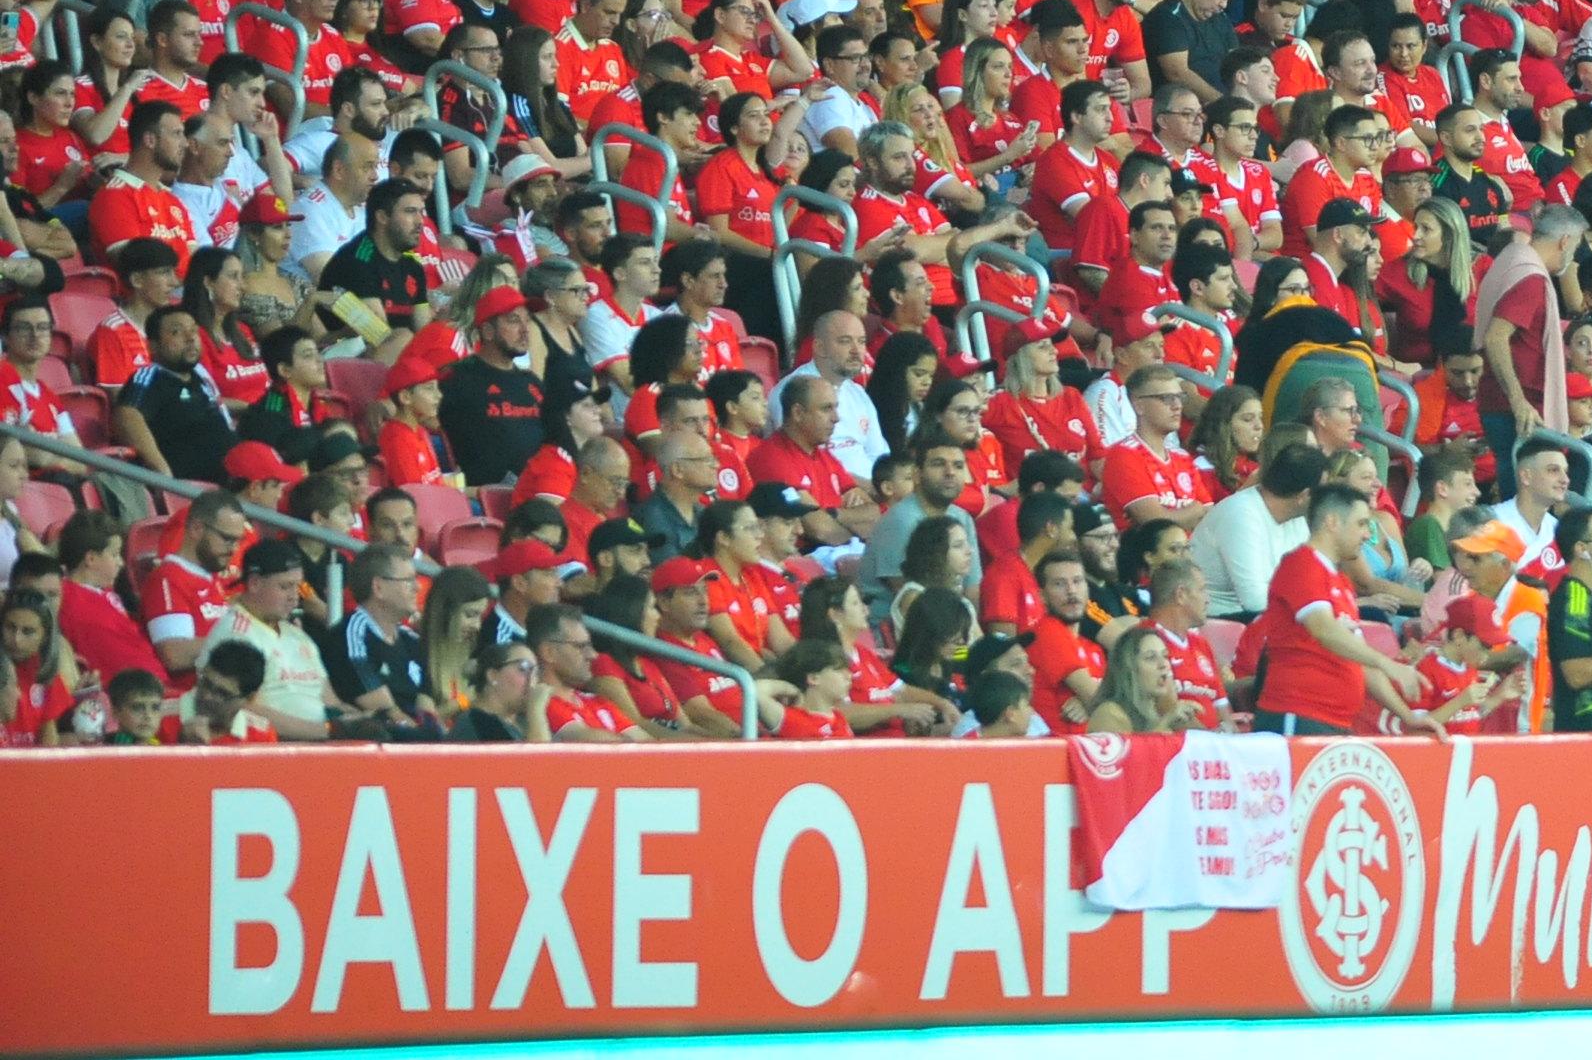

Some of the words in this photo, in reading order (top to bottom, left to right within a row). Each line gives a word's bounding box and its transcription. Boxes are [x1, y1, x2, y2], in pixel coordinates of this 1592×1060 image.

[1407, 94, 1425, 112] 10
[208, 785, 701, 1016] BAIXE
[751, 782, 869, 1007] O
